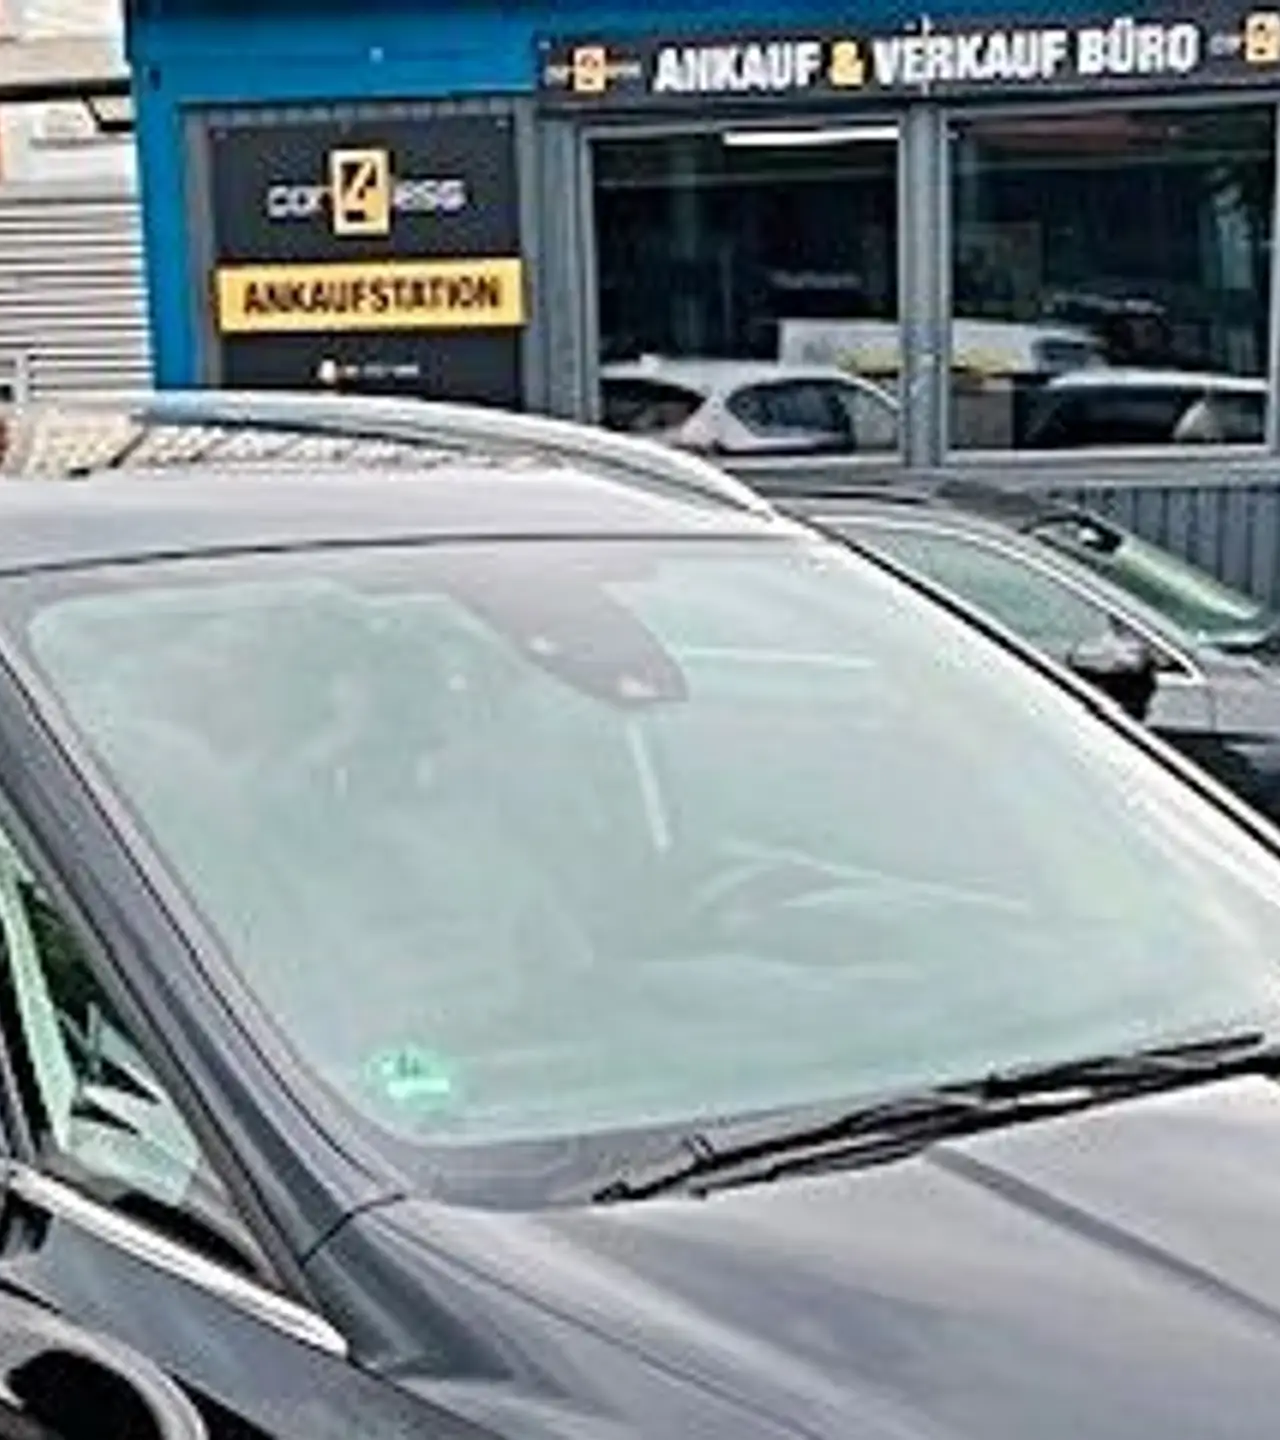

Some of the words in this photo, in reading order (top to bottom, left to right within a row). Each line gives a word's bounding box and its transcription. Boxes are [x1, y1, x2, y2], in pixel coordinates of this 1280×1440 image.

[653, 43, 821, 92] ANKAUF
[829, 40, 864, 86] &
[873, 29, 1068, 86] VERKAUF
[1078, 15, 1199, 75] BÜRO
[243, 275, 501, 316] ANKAUFSTATION
